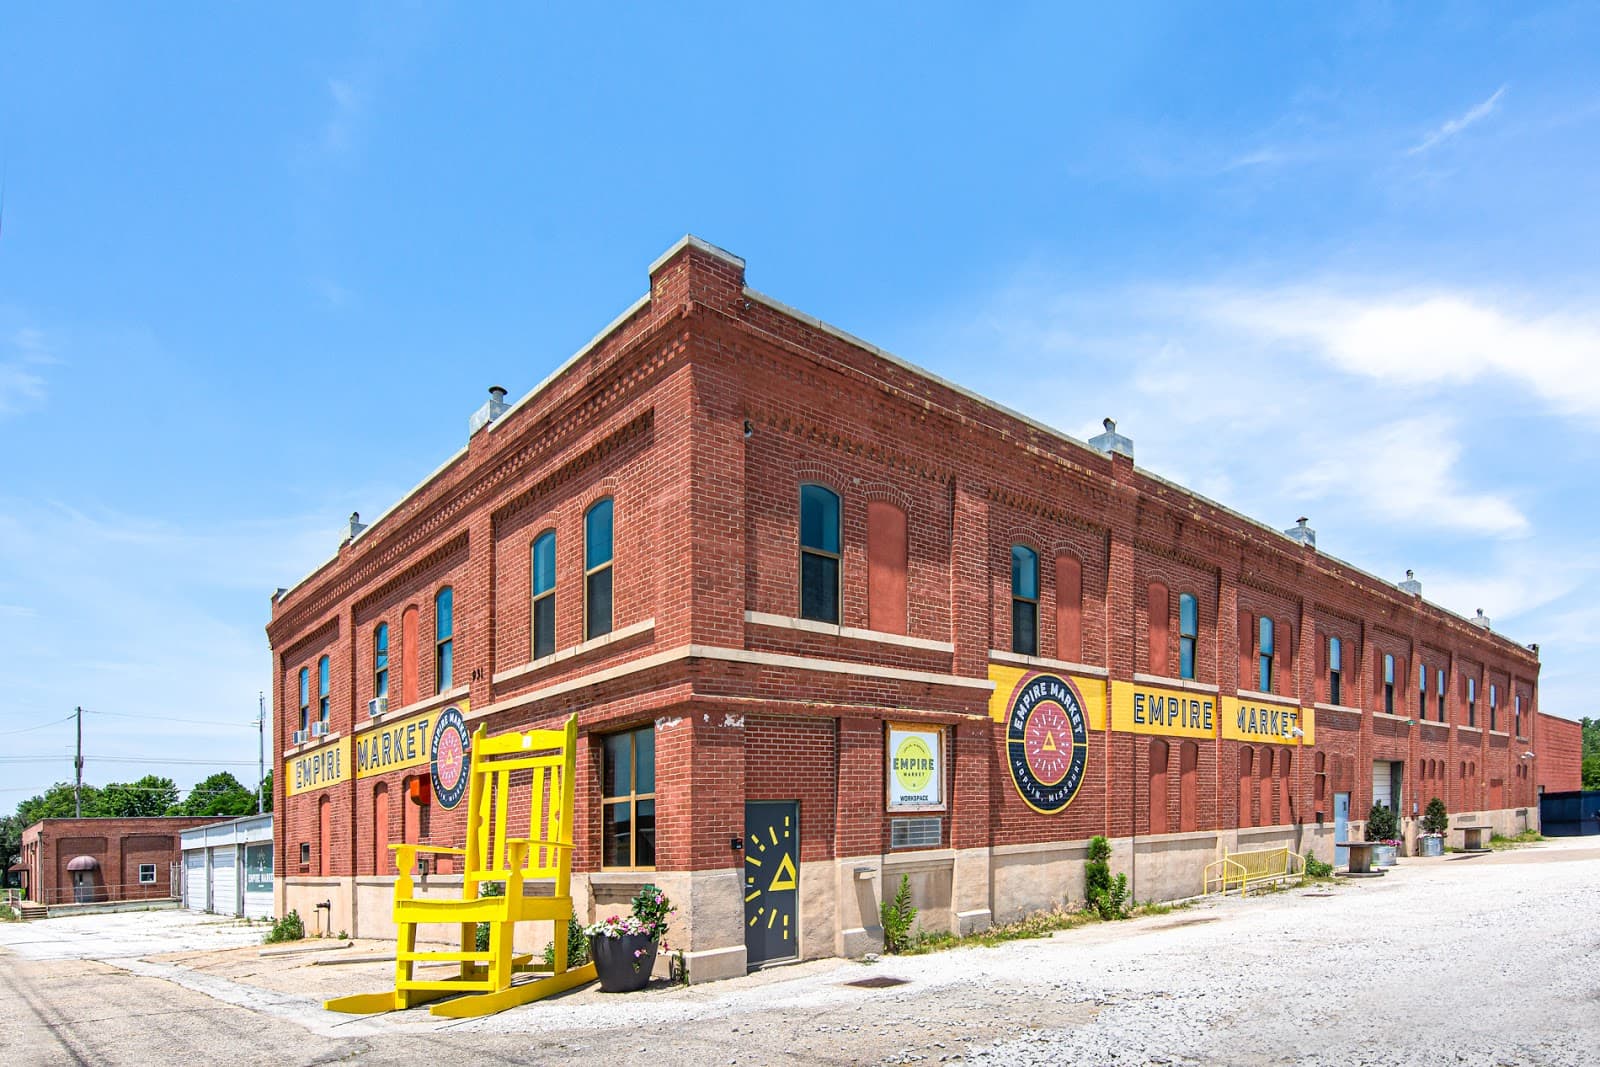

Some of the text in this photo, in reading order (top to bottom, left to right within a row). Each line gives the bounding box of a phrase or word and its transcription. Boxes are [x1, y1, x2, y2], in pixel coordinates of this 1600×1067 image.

[1014, 682, 1082, 734] EMPIRE MARKET
[1133, 693, 1297, 737] EMPIRE MARKET
[295, 719, 429, 789] EMPIRE MARKET
[432, 712, 468, 754] EMPIRE MARKET
[893, 757, 935, 771] EMPIRE
[1049, 760, 1081, 802] MISSOURI
